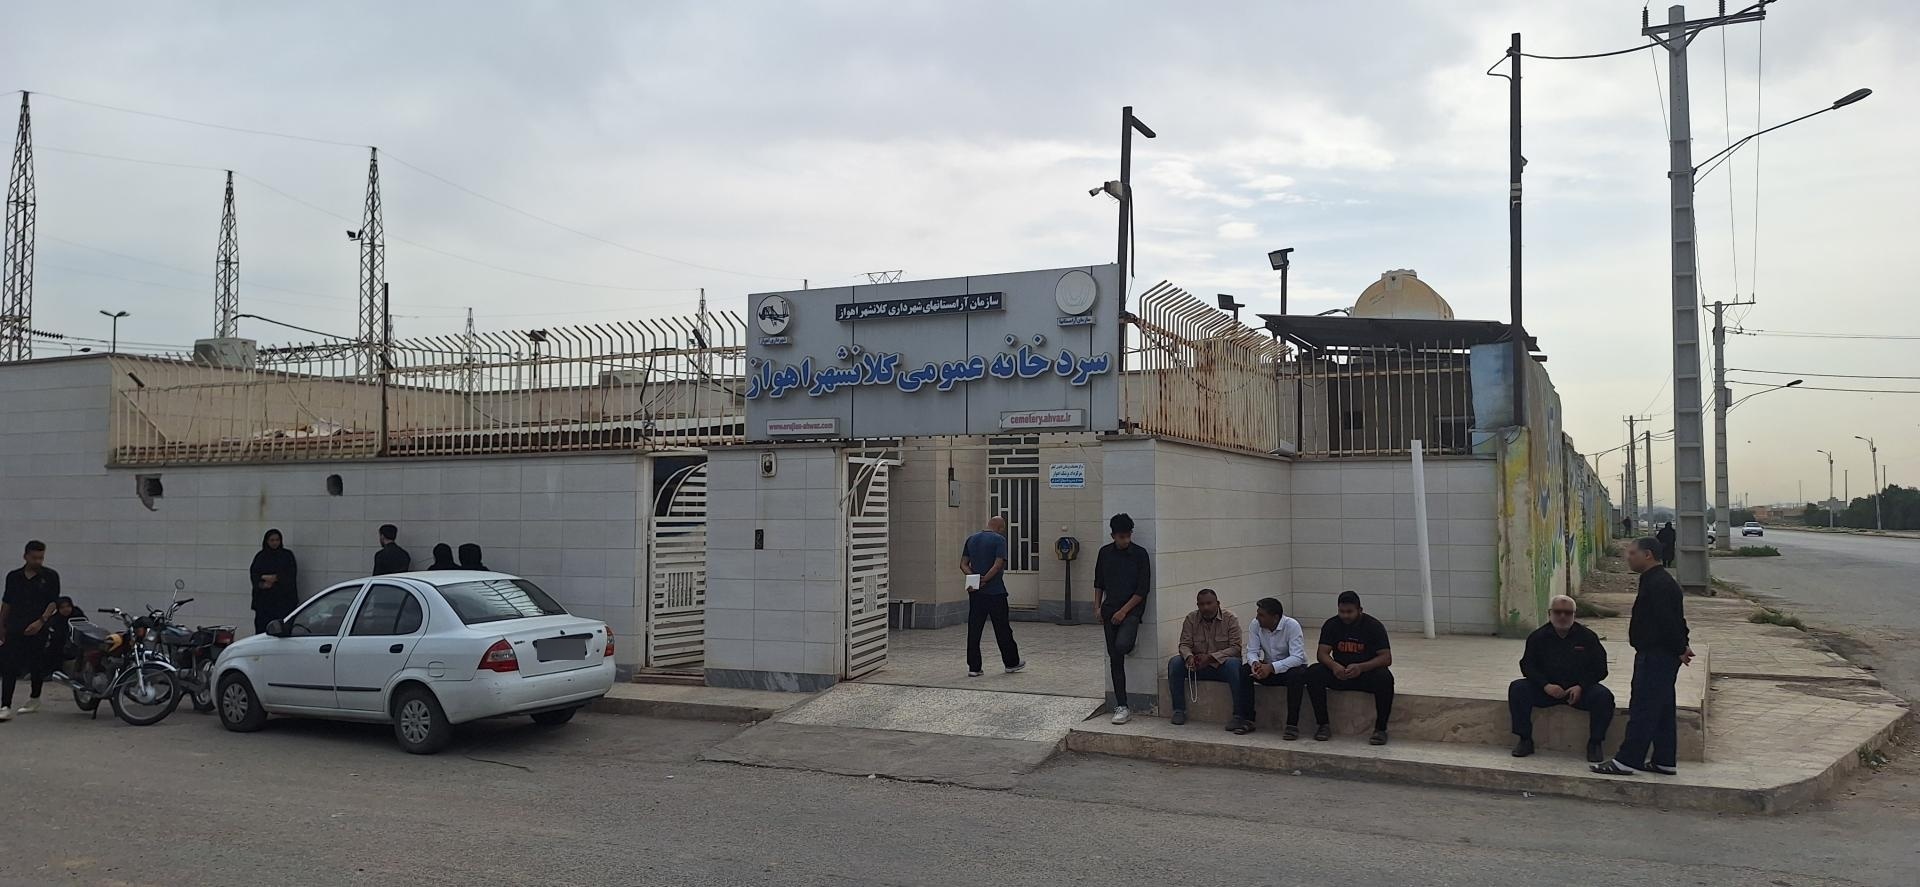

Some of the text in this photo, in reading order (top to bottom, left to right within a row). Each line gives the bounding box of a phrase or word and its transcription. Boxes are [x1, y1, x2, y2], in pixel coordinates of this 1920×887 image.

[838, 295, 999, 319] سازمان آرامستانهای شهرداری کلانشهر اهواز
[746, 356, 812, 399] اهواز
[808, 345, 899, 397] کلانشهر
[897, 354, 986, 392] عمومی
